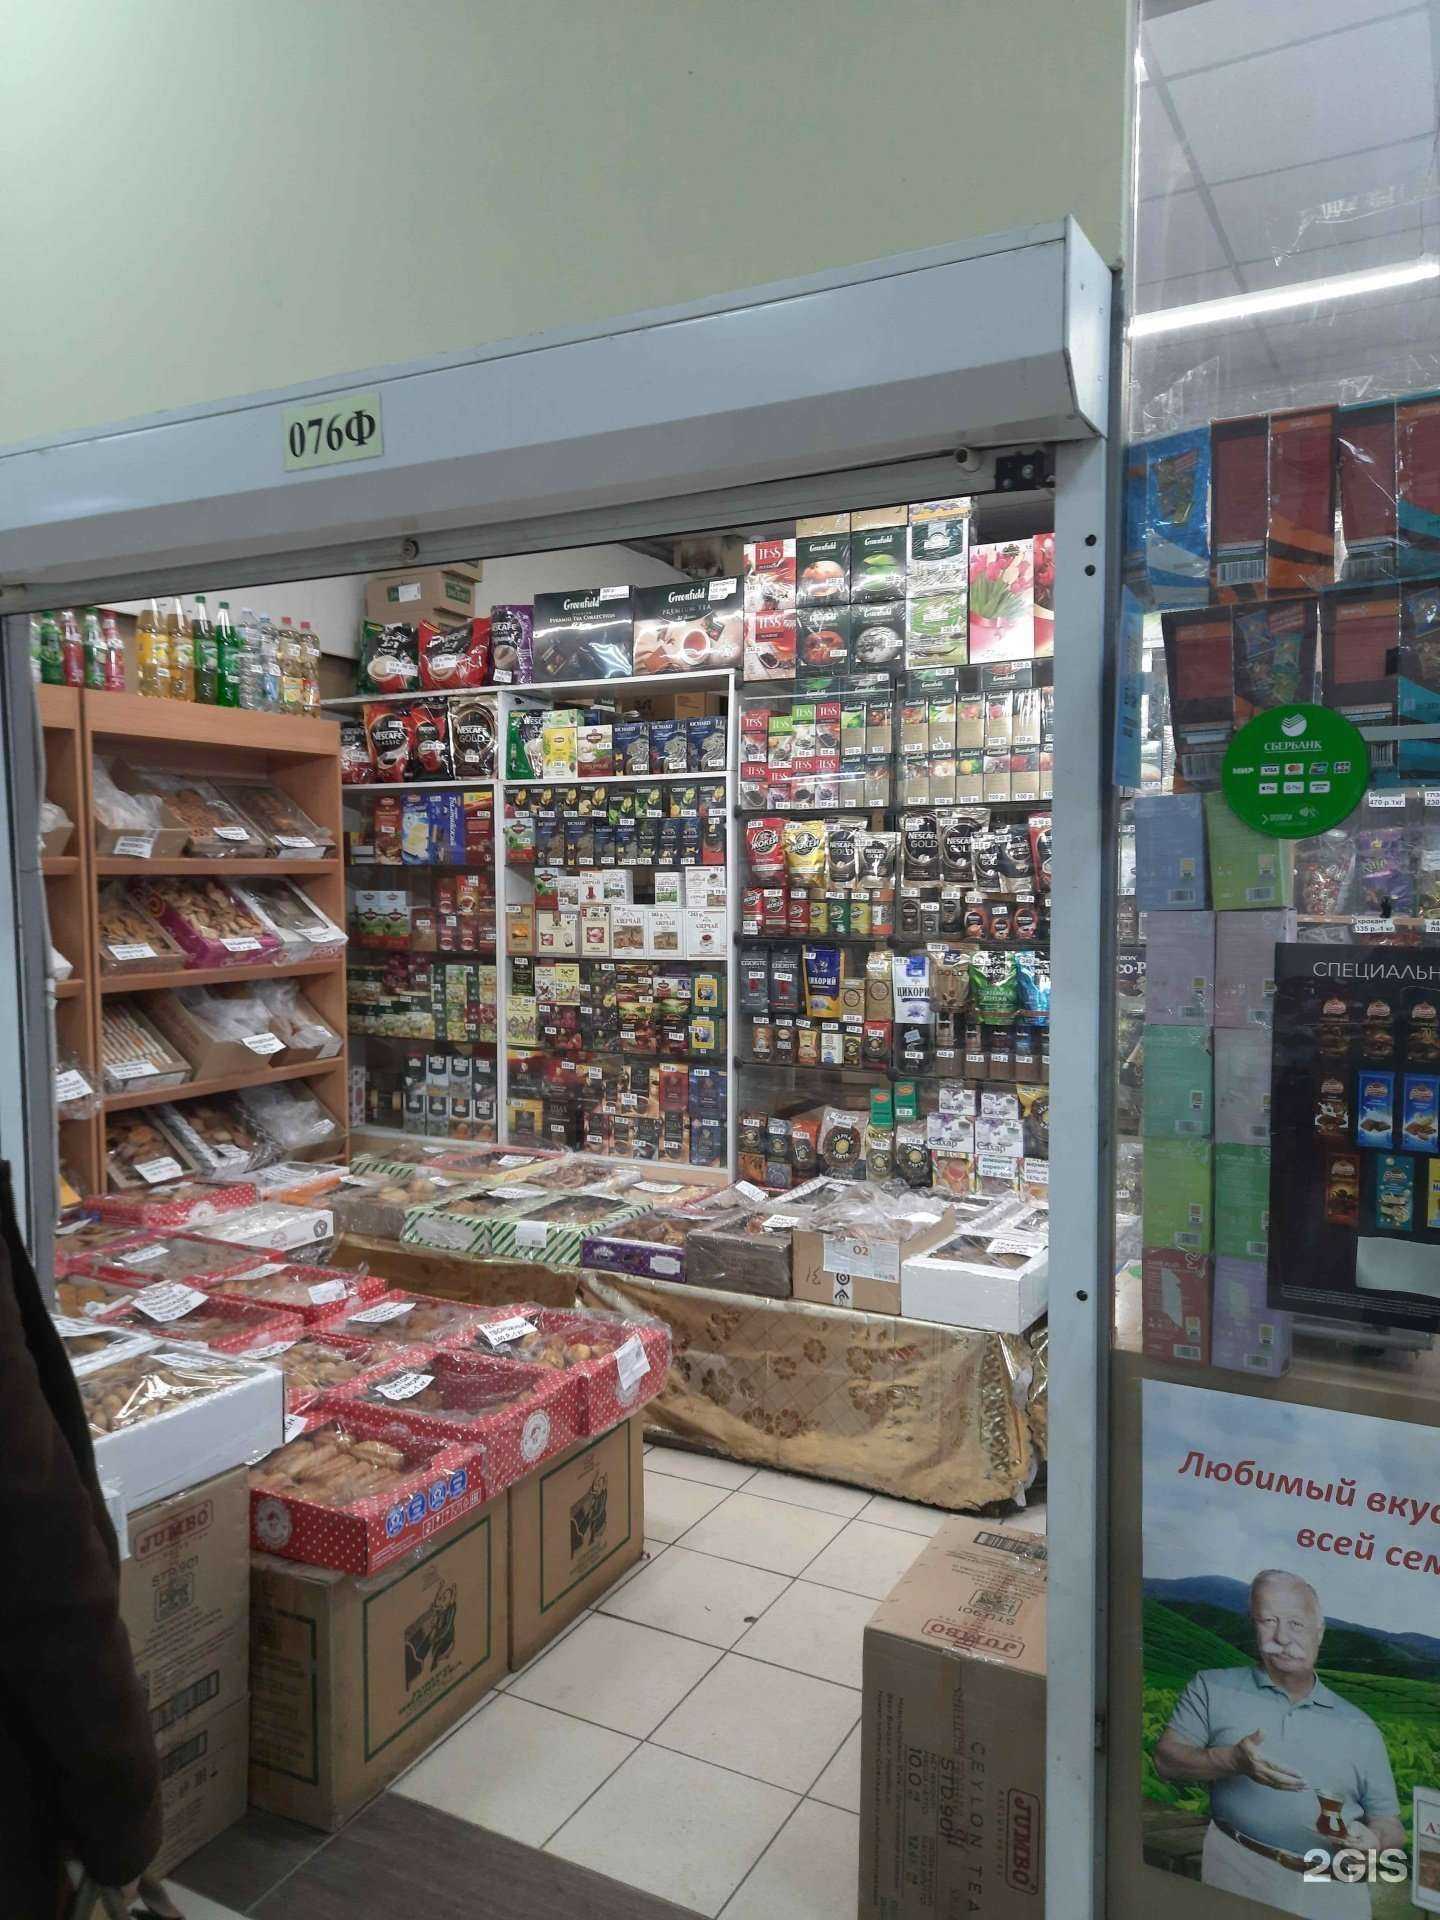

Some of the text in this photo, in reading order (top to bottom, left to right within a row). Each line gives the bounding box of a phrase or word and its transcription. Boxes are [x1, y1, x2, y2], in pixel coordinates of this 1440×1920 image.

[289, 409, 376, 458] 076Ф
[563, 597, 600, 611] Greenfield
[668, 588, 705, 603] Greenfield
[1263, 741, 1323, 752] СБЕРБАНК
[911, 840, 938, 848] GOLD
[951, 844, 969, 853] GOL
[897, 986, 929, 998] ЦИКОРИ
[1178, 1450, 1356, 1507] Любимый
[141, 1509, 210, 1553] JUMBO
[1297, 1528, 1375, 1561] всей
[931, 1623, 1018, 1654] JUMBO
[966, 1741, 986, 1913] CEYLON TEA
[1012, 1797, 1034, 1888] JUMBO
